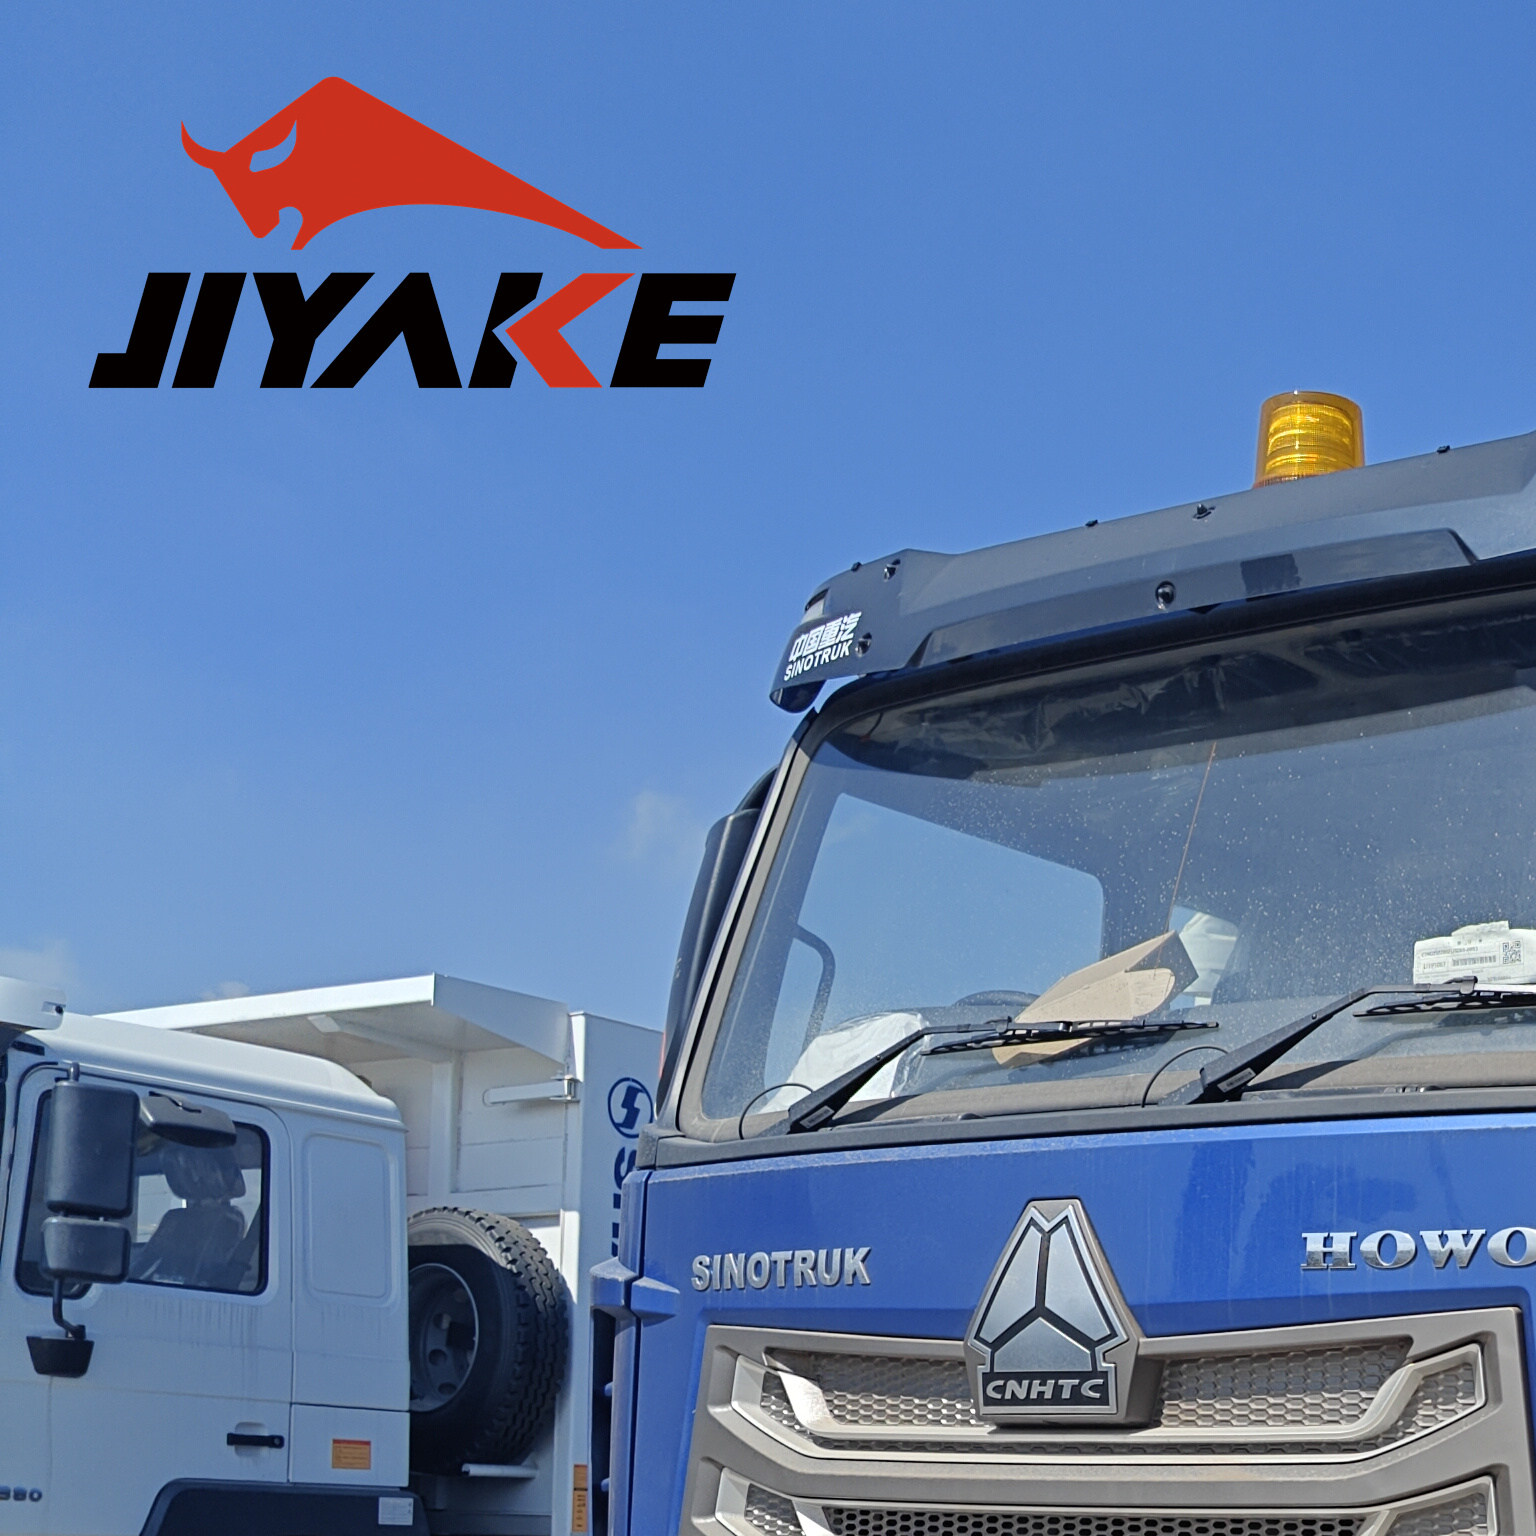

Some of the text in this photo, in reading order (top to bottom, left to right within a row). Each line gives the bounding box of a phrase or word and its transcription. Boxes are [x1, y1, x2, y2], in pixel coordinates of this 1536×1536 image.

[788, 611, 862, 662] 中国重汽
[783, 639, 853, 681] SINOTRUK
[691, 1246, 872, 1292] SINOTRUK
[985, 1378, 1105, 1401] CNHTC
